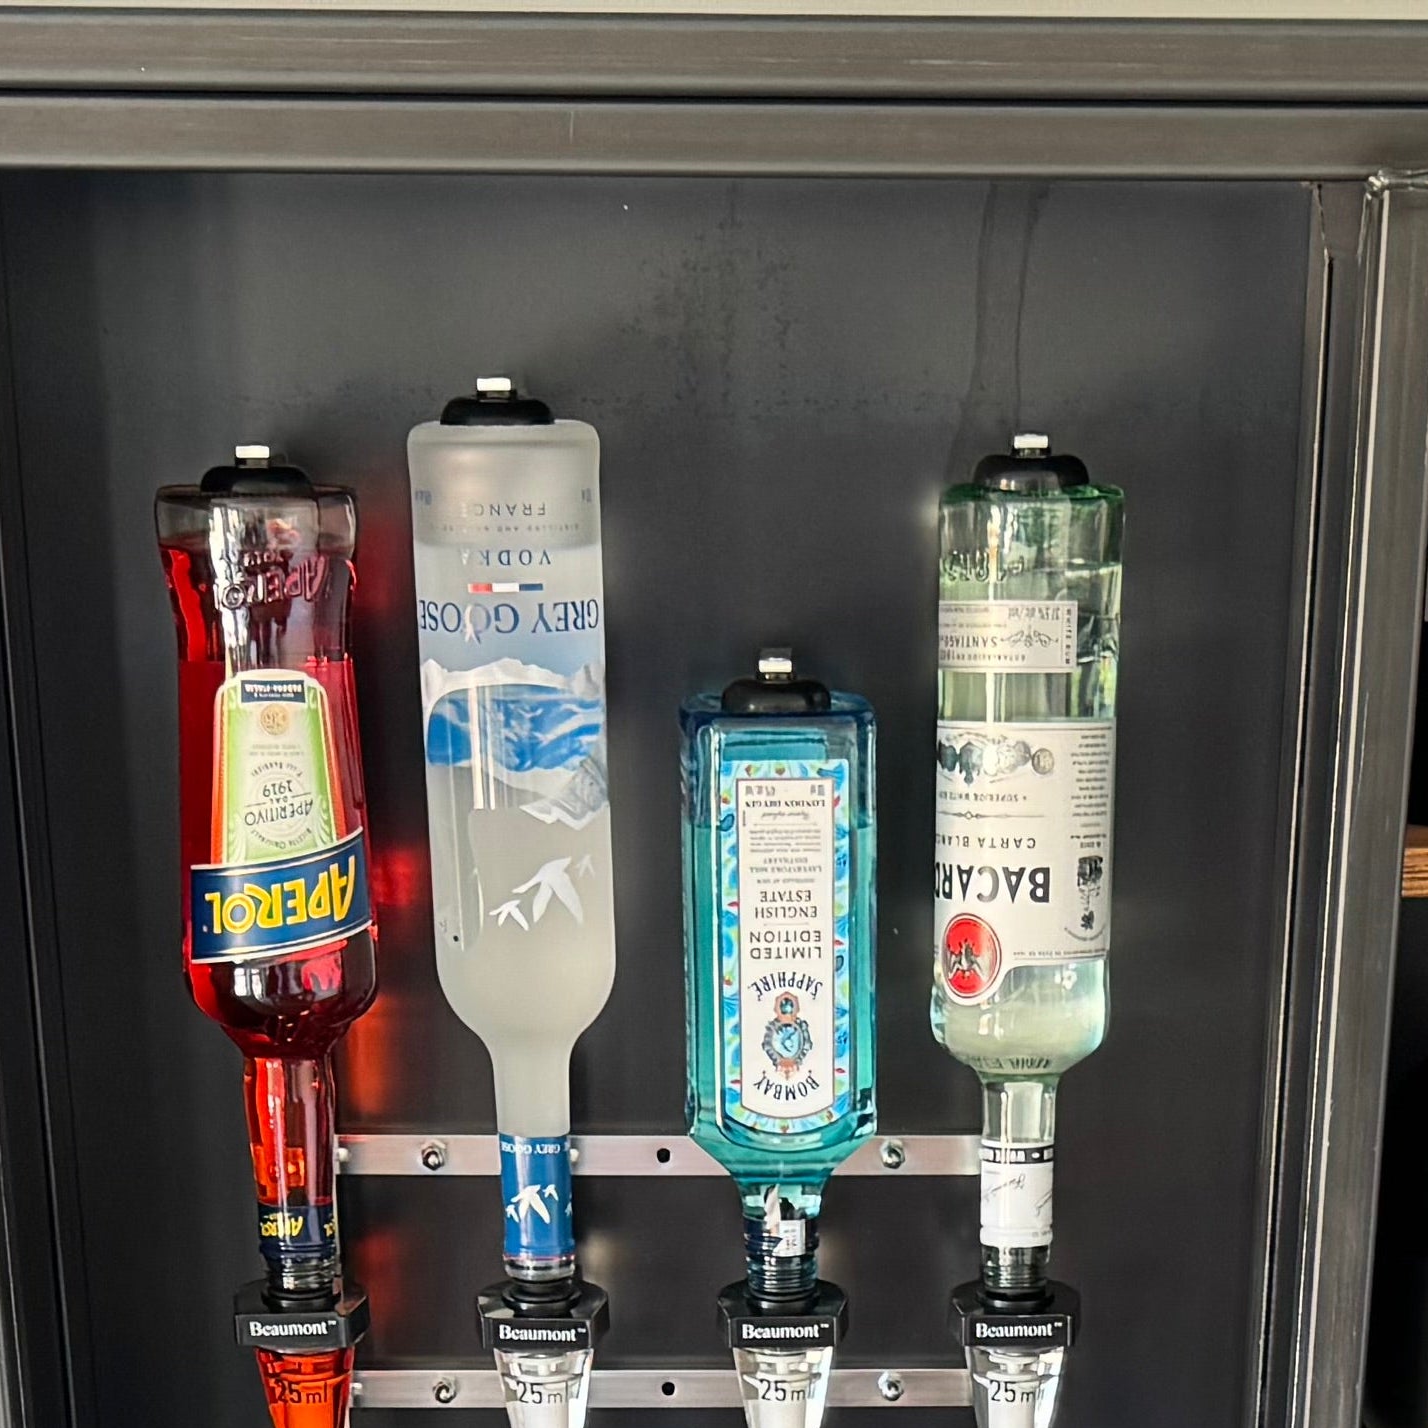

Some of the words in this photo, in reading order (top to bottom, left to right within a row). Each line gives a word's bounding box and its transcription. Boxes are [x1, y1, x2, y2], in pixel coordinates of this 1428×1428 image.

[458, 549, 552, 566] VODKA
[418, 599, 520, 640] GOOSE
[530, 599, 599, 634] GREY
[262, 780, 294, 797] 1919
[244, 798, 313, 827] APERITIVO
[977, 837, 1037, 850] CARTA
[204, 854, 357, 936] APEROL
[759, 889, 812, 903] ESTATE
[754, 905, 818, 919] ENGLISH
[748, 929, 822, 944] EDITION
[749, 946, 822, 960] LIMITED
[748, 971, 824, 1002] SAPPHIRE
[753, 1074, 820, 1101] BOMBAY
[275, 1378, 302, 1404] 25
[305, 1387, 328, 1404] ml
[517, 1381, 543, 1405] 25
[761, 1378, 787, 1402] 25
[991, 1379, 1017, 1403] 25
